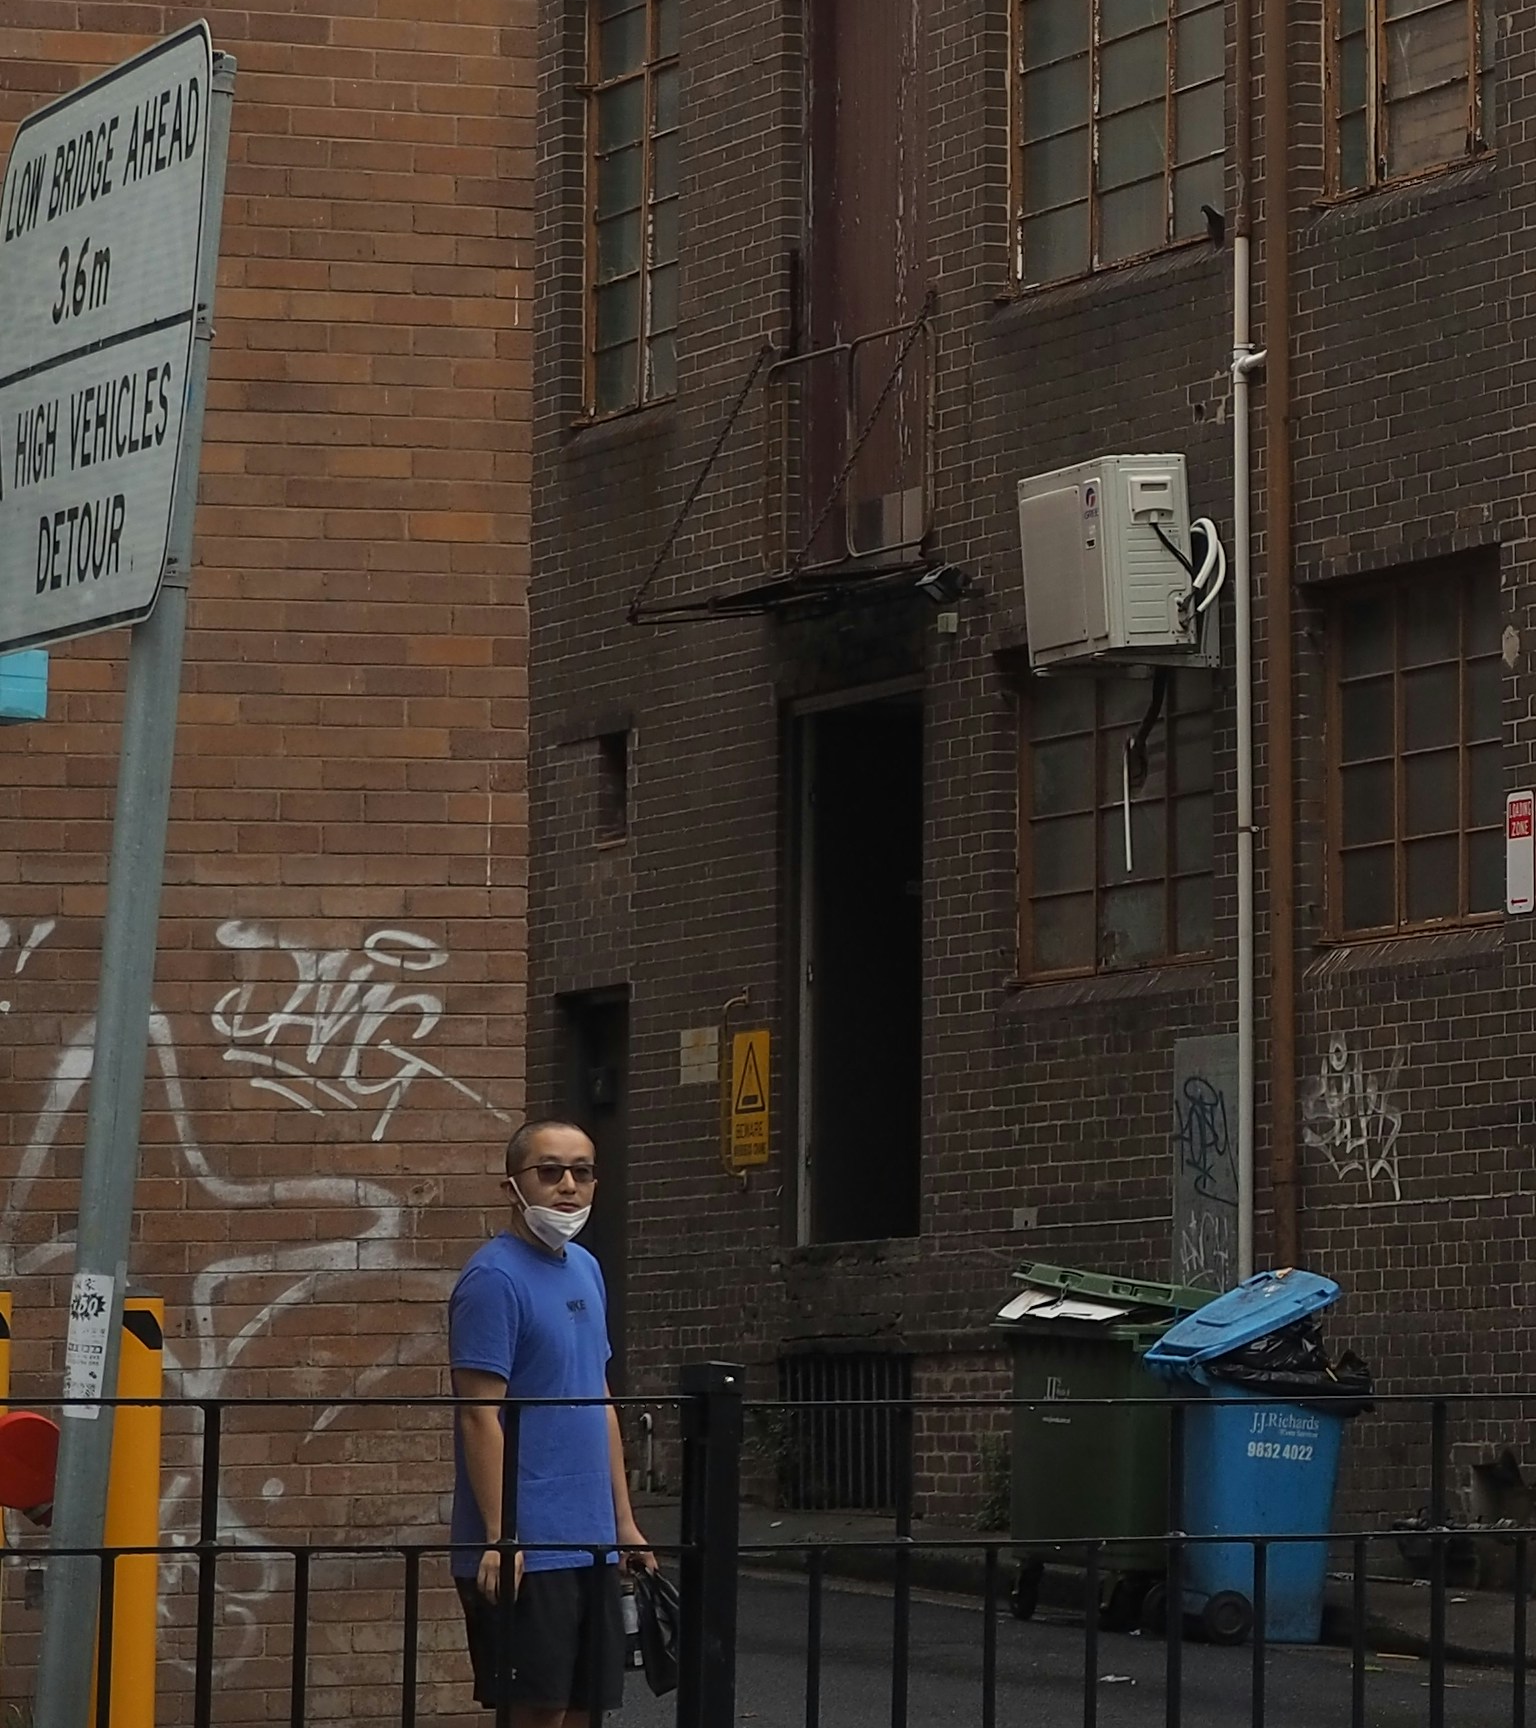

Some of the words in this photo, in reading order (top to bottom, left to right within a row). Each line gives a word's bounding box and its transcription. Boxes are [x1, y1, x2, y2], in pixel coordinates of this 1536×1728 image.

[5, 152, 46, 243] LOW
[48, 117, 119, 221] BRIDGE
[123, 76, 200, 184] AHEAD
[52, 235, 111, 326] 3.6m
[14, 400, 59, 489] HIGH
[69, 360, 172, 472] VEHICLES
[36, 492, 126, 595] DETOUR
[1509, 801, 1531, 818] LOADING
[1511, 820, 1529, 837] ZONE
[1282, 1444, 1313, 1461] 4022
